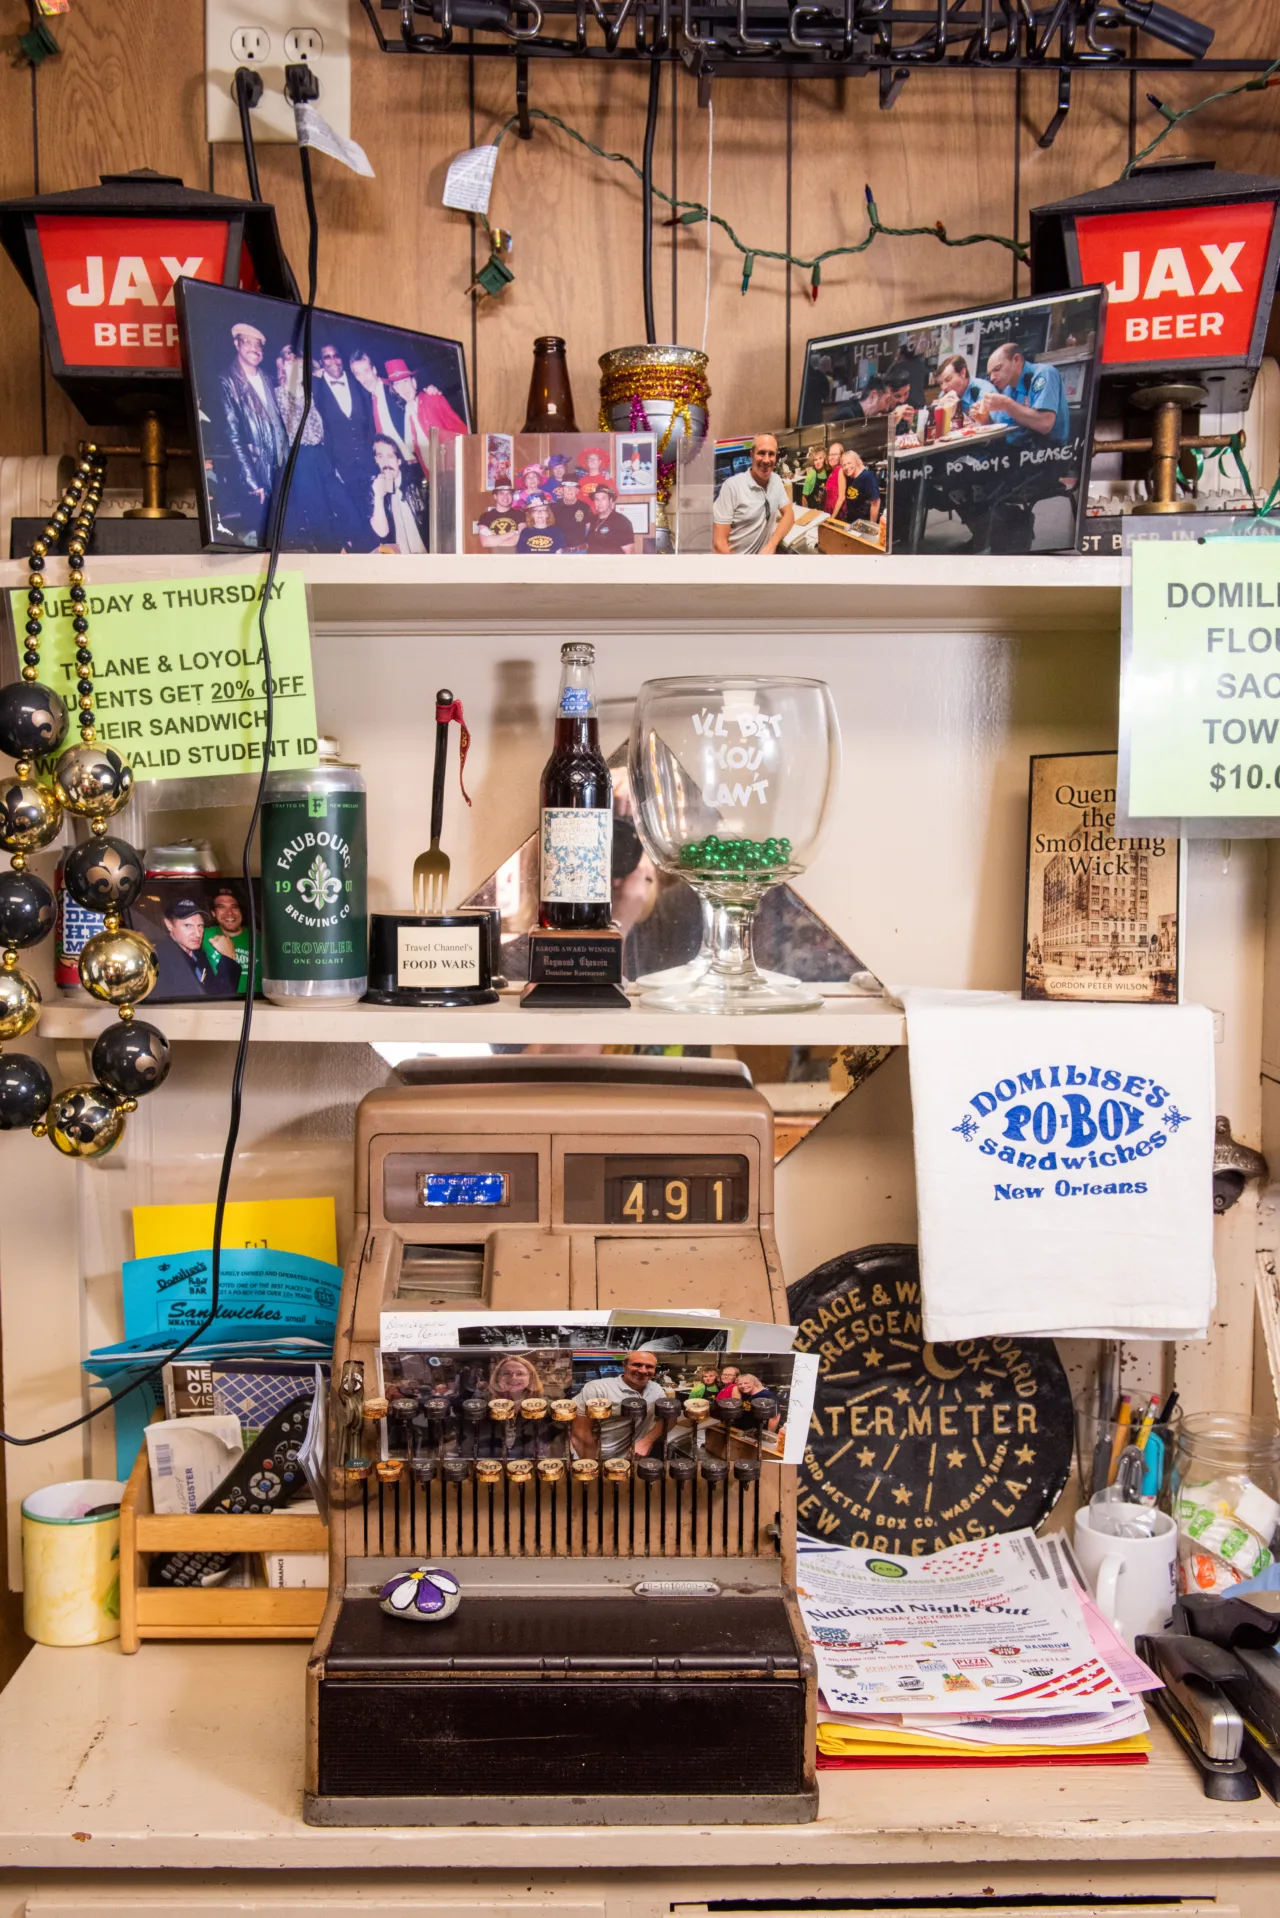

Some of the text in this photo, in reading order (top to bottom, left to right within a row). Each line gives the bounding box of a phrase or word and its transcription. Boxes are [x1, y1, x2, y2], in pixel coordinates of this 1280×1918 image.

[66, 256, 203, 306] JAX
[1106, 241, 1246, 304] JAX
[1125, 312, 1225, 342] BEER
[854, 341, 893, 365] HELL
[42, 582, 285, 618] UEDAY & THURSDAY
[60, 656, 150, 680] TLANE
[157, 655, 173, 672] &
[160, 683, 204, 704] GET
[211, 679, 255, 700] 20%
[297, 736, 318, 756] ID
[1082, 807, 1116, 828] the
[1069, 854, 1131, 876] Wick
[275, 880, 292, 893] 19
[285, 904, 339, 928] BREWING
[282, 941, 353, 954] CROWLER
[405, 943, 473, 952] Travel Channel's
[402, 959, 476, 970] FOOD WARS
[1050, 980, 1149, 991] GORDON PETER WILSON
[969, 1065, 1171, 1118] DOMILISE'S
[978, 1130, 1168, 1171] Sandwiches
[993, 1179, 1149, 1201] New Orleans
[871, 1285, 891, 1306] &
[284, 1315, 307, 1323] small
[908, 1405, 1038, 1437] METER
[822, 1481, 871, 1522] METER
[875, 1514, 908, 1530] BOX
[805, 1604, 1031, 1621] National Night Out
[1024, 1642, 1070, 1650] RAINBOW
[865, 1663, 914, 1673] gracious
